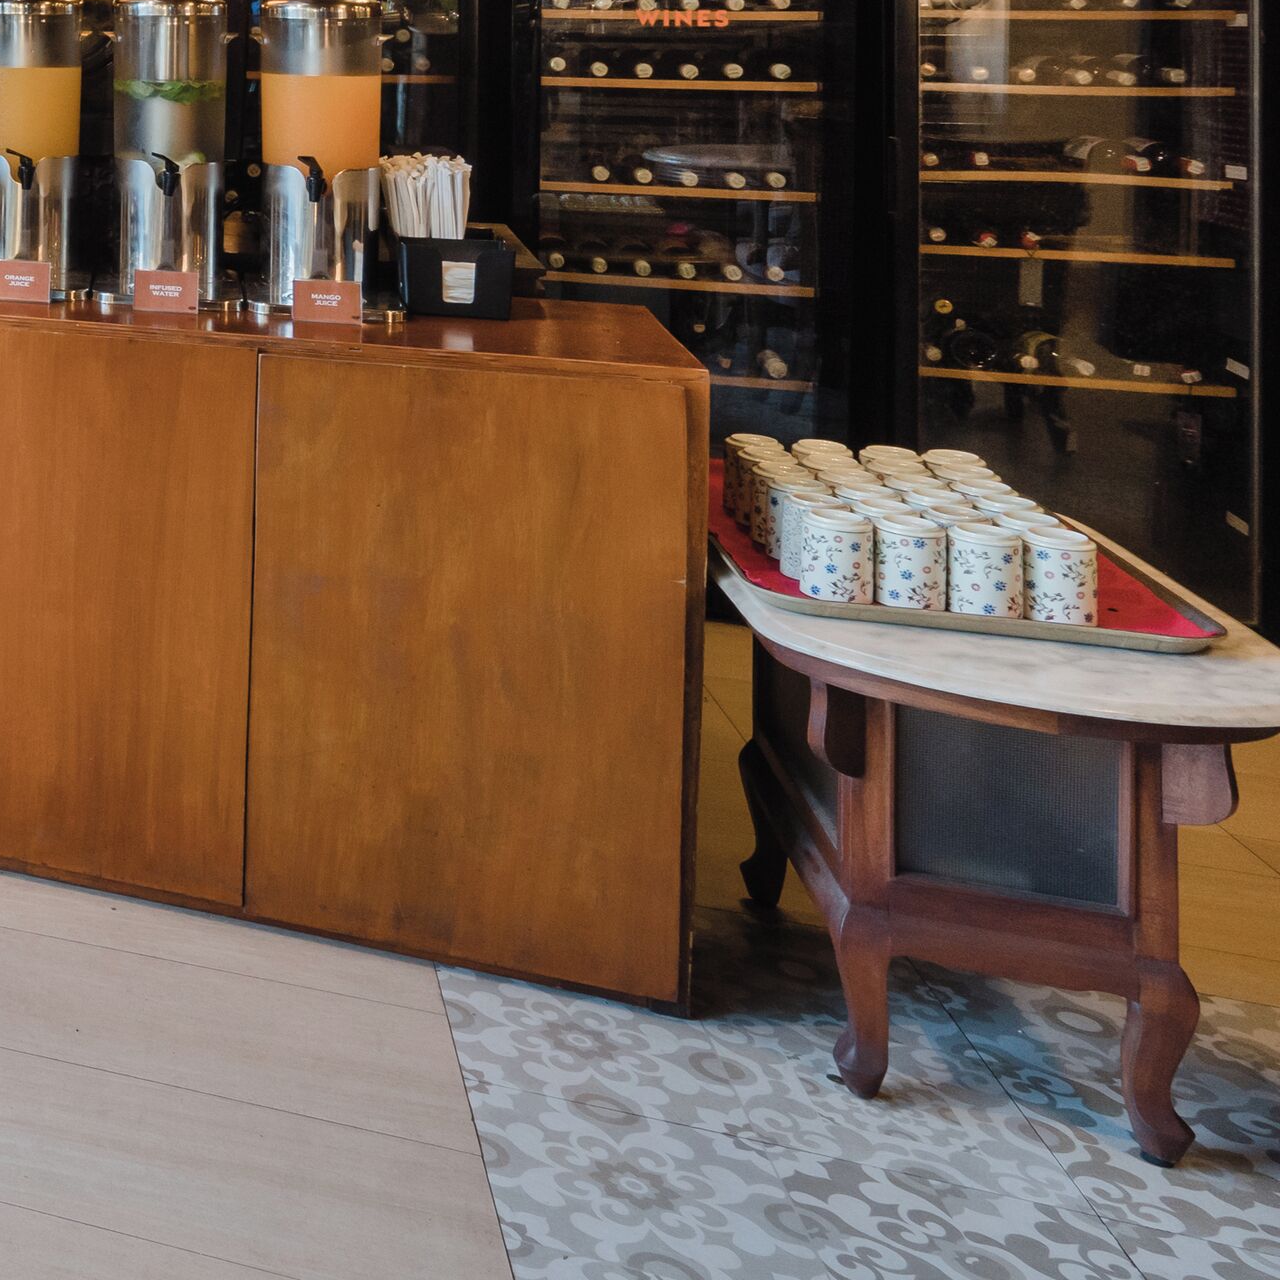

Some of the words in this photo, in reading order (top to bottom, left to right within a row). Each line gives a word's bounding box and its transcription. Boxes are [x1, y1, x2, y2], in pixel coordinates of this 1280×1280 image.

[636, 10, 730, 27] WINES
[4, 274, 35, 282] ORANGE
[8, 280, 30, 288] JUICE
[149, 283, 183, 292] INFUSED
